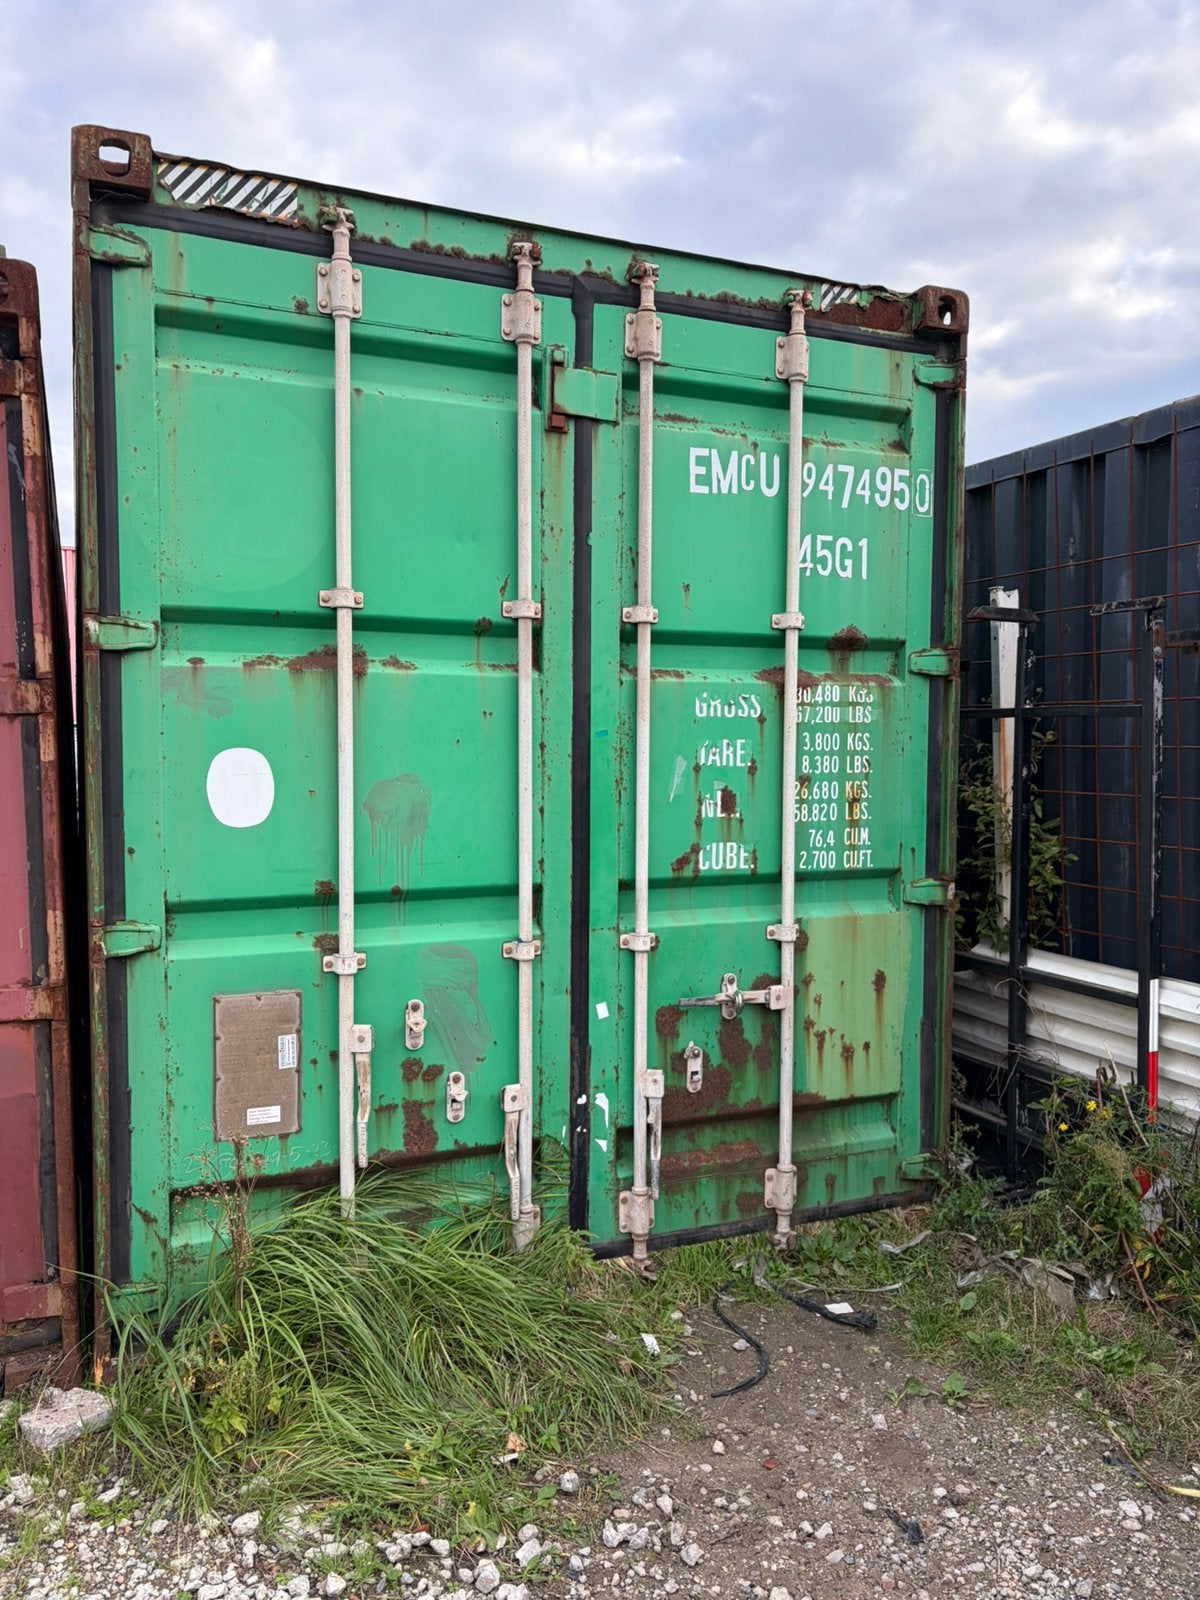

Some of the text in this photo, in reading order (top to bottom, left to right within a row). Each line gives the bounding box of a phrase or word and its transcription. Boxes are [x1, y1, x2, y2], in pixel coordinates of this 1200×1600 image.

[689, 446, 780, 498] EMCU
[798, 533, 868, 580] 45G1
[802, 731, 874, 751] 3,800 KGS.
[801, 755, 873, 774] 8,380 LBS.
[845, 780, 872, 799] KGS.
[845, 801, 872, 821] LBS.
[799, 850, 836, 870] 2,700
